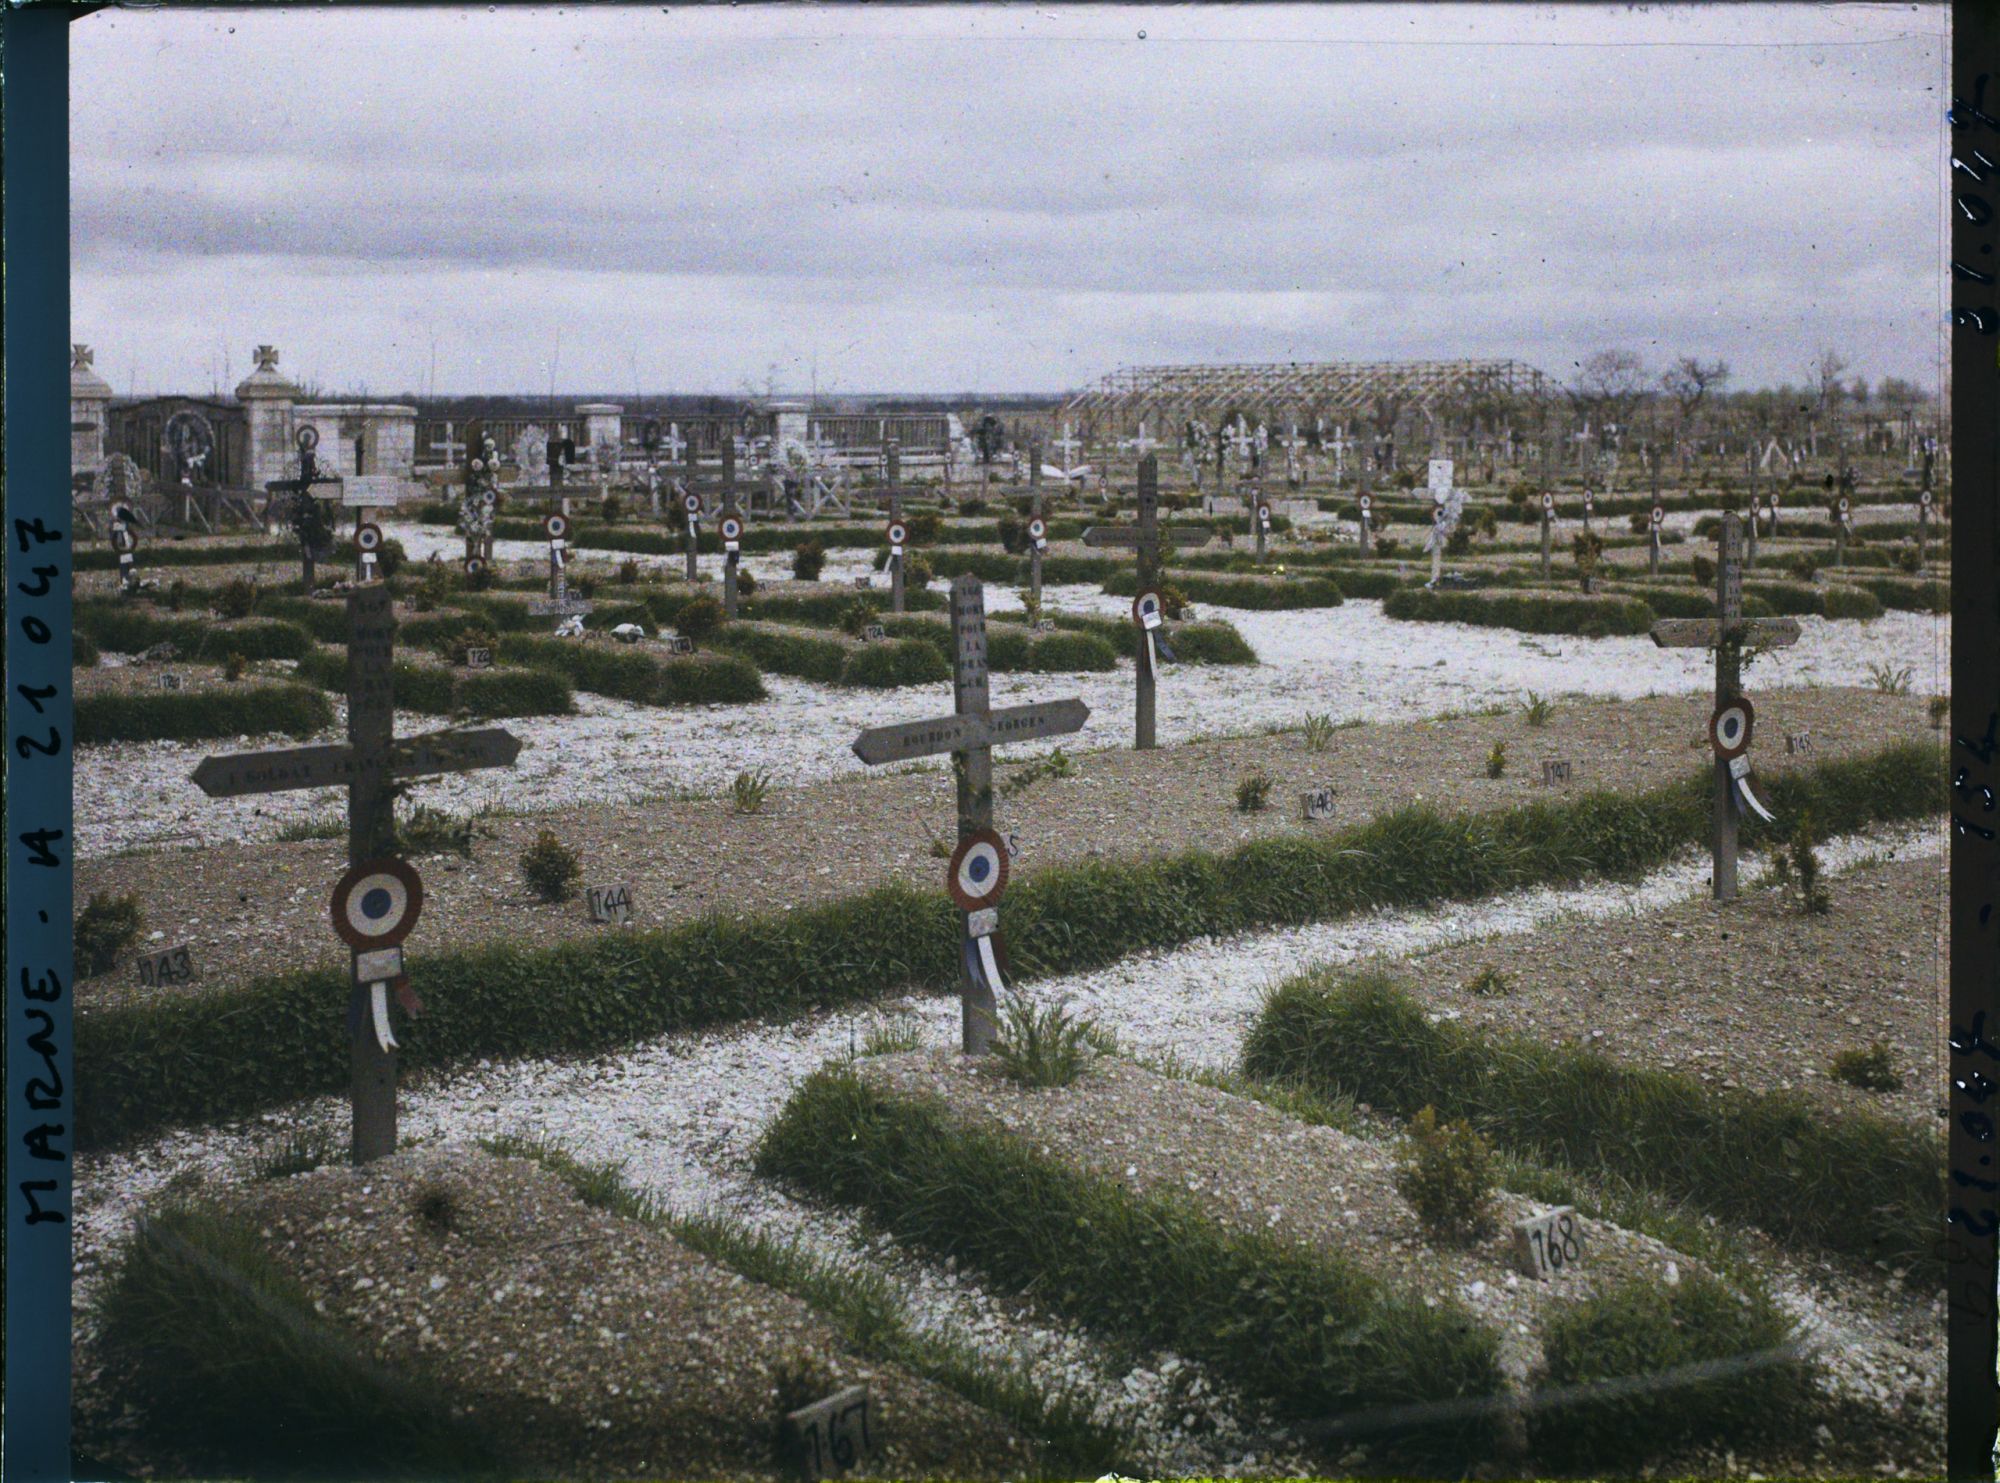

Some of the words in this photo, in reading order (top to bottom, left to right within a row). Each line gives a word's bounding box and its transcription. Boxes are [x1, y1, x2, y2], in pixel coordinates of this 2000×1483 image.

[1793, 734, 1814, 754] 148
[1550, 763, 1570, 783] 147
[594, 887, 632, 914] 144
[145, 951, 191, 987] 143
[20, 966, 65, 1224] MARNE
[1531, 1214, 1580, 1271] 168
[804, 1400, 872, 1475] 167
